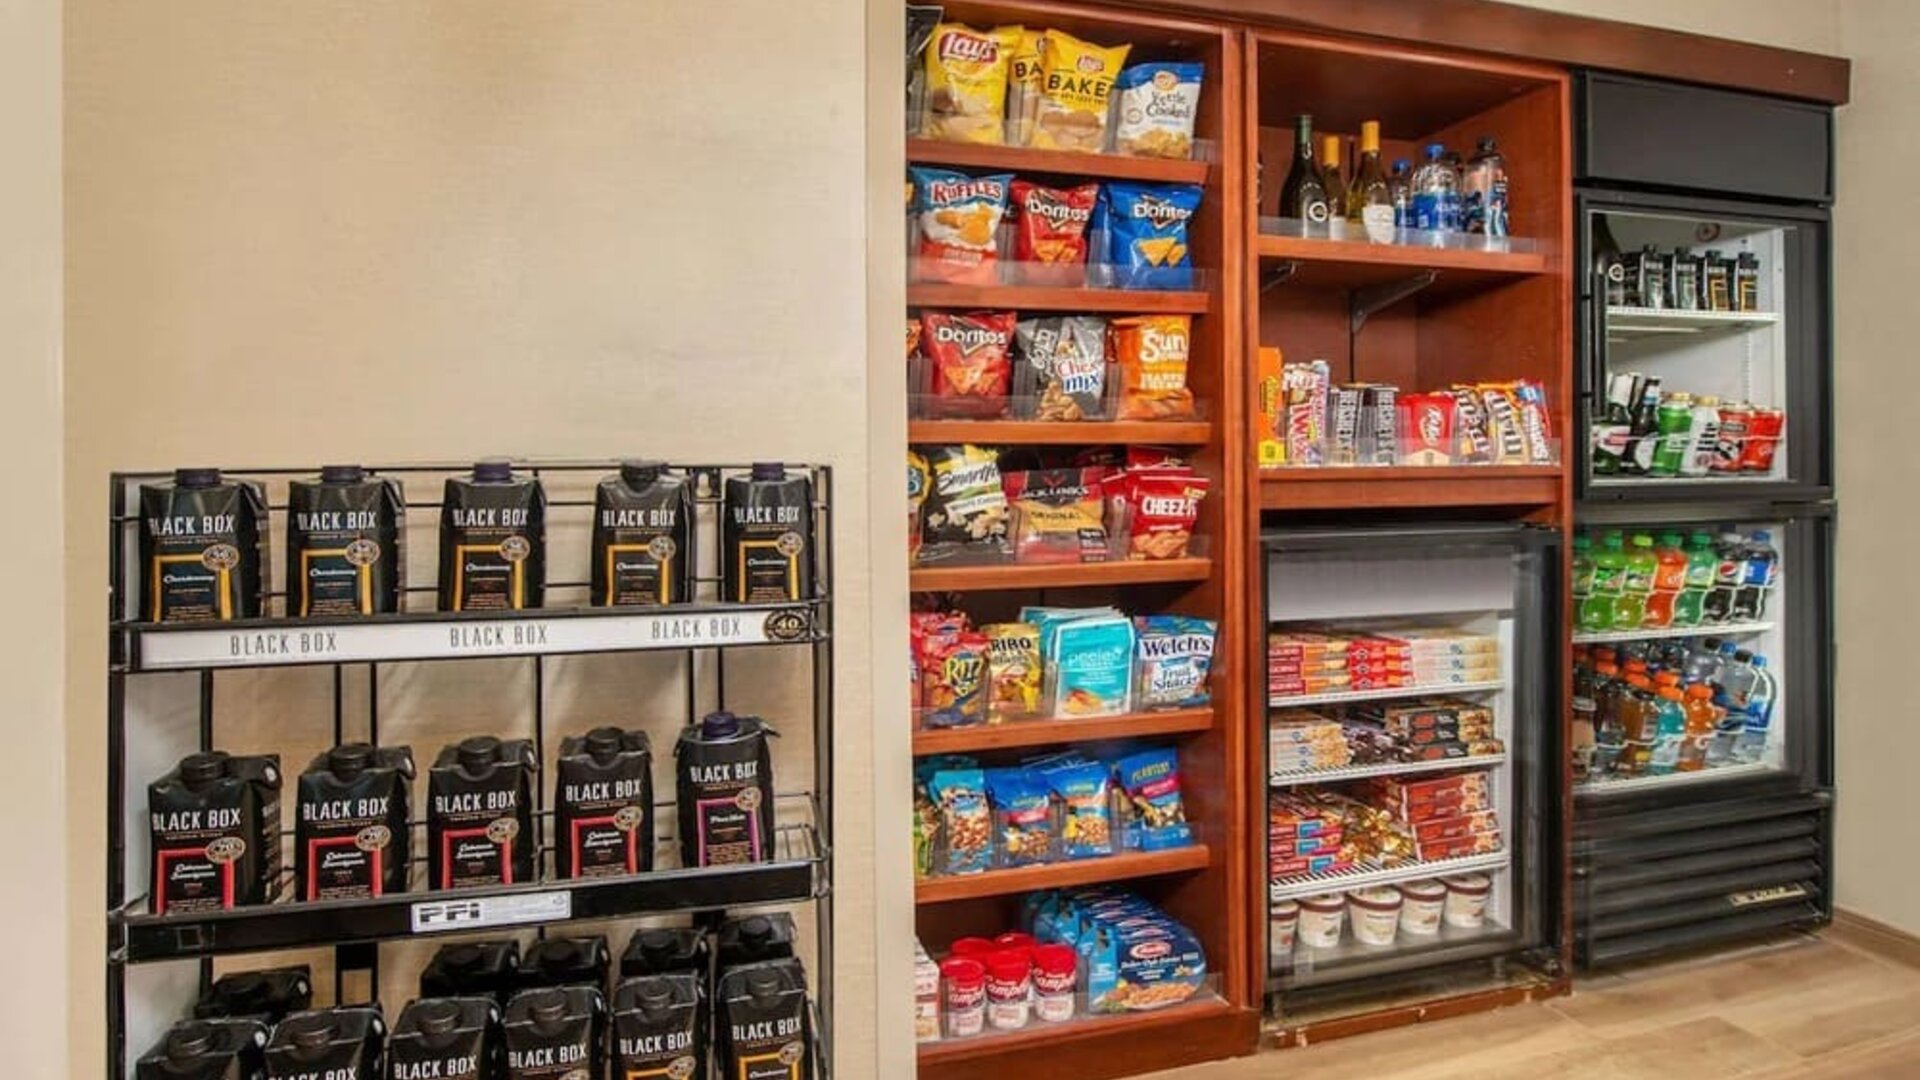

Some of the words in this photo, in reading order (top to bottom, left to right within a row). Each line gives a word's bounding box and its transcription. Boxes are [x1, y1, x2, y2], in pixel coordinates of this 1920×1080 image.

[942, 33, 998, 60] Lay's
[1048, 74, 1107, 97] BAKE
[934, 181, 1001, 202] RUFFLES
[1028, 199, 1089, 221] Doritos
[1133, 202, 1192, 219] Doritos
[938, 326, 1007, 344] Doritos
[149, 516, 197, 536] BLACK
[203, 514, 234, 533] BOX
[297, 511, 342, 531] BLACK
[347, 510, 376, 529] BOX
[453, 508, 498, 527] BLACK
[503, 507, 529, 526] BOX
[602, 509, 648, 527] BLACK
[651, 508, 675, 526] BOX
[735, 506, 774, 524] BLACK
[778, 505, 800, 522] BOX
[450, 627, 502, 648] BLACK
[514, 625, 548, 645] BOX
[652, 619, 701, 640] BLACK
[710, 617, 741, 638] BOX
[231, 633, 290, 656] BLACK
[300, 632, 337, 653] BOX
[990, 637, 1032, 651] RIBO
[1143, 637, 1211, 657] Welch's
[690, 763, 730, 782] BLACK
[735, 761, 757, 778] BOX
[436, 792, 481, 813] BLACK
[487, 790, 516, 809] BOX
[565, 782, 611, 802] BLACK
[615, 779, 641, 797] BOX
[152, 810, 200, 831] BLACK
[208, 807, 241, 827] BOX
[303, 800, 351, 821] BLACK
[358, 797, 389, 816] BOX
[732, 1021, 774, 1040] BLACK
[778, 1016, 802, 1034] BOX
[619, 1036, 662, 1055] BLACK
[668, 1031, 693, 1049] BOX
[508, 1048, 554, 1067] BLACK
[558, 1043, 587, 1062] BOX
[393, 1061, 440, 1080] BLACK
[447, 1056, 477, 1074] BOX
